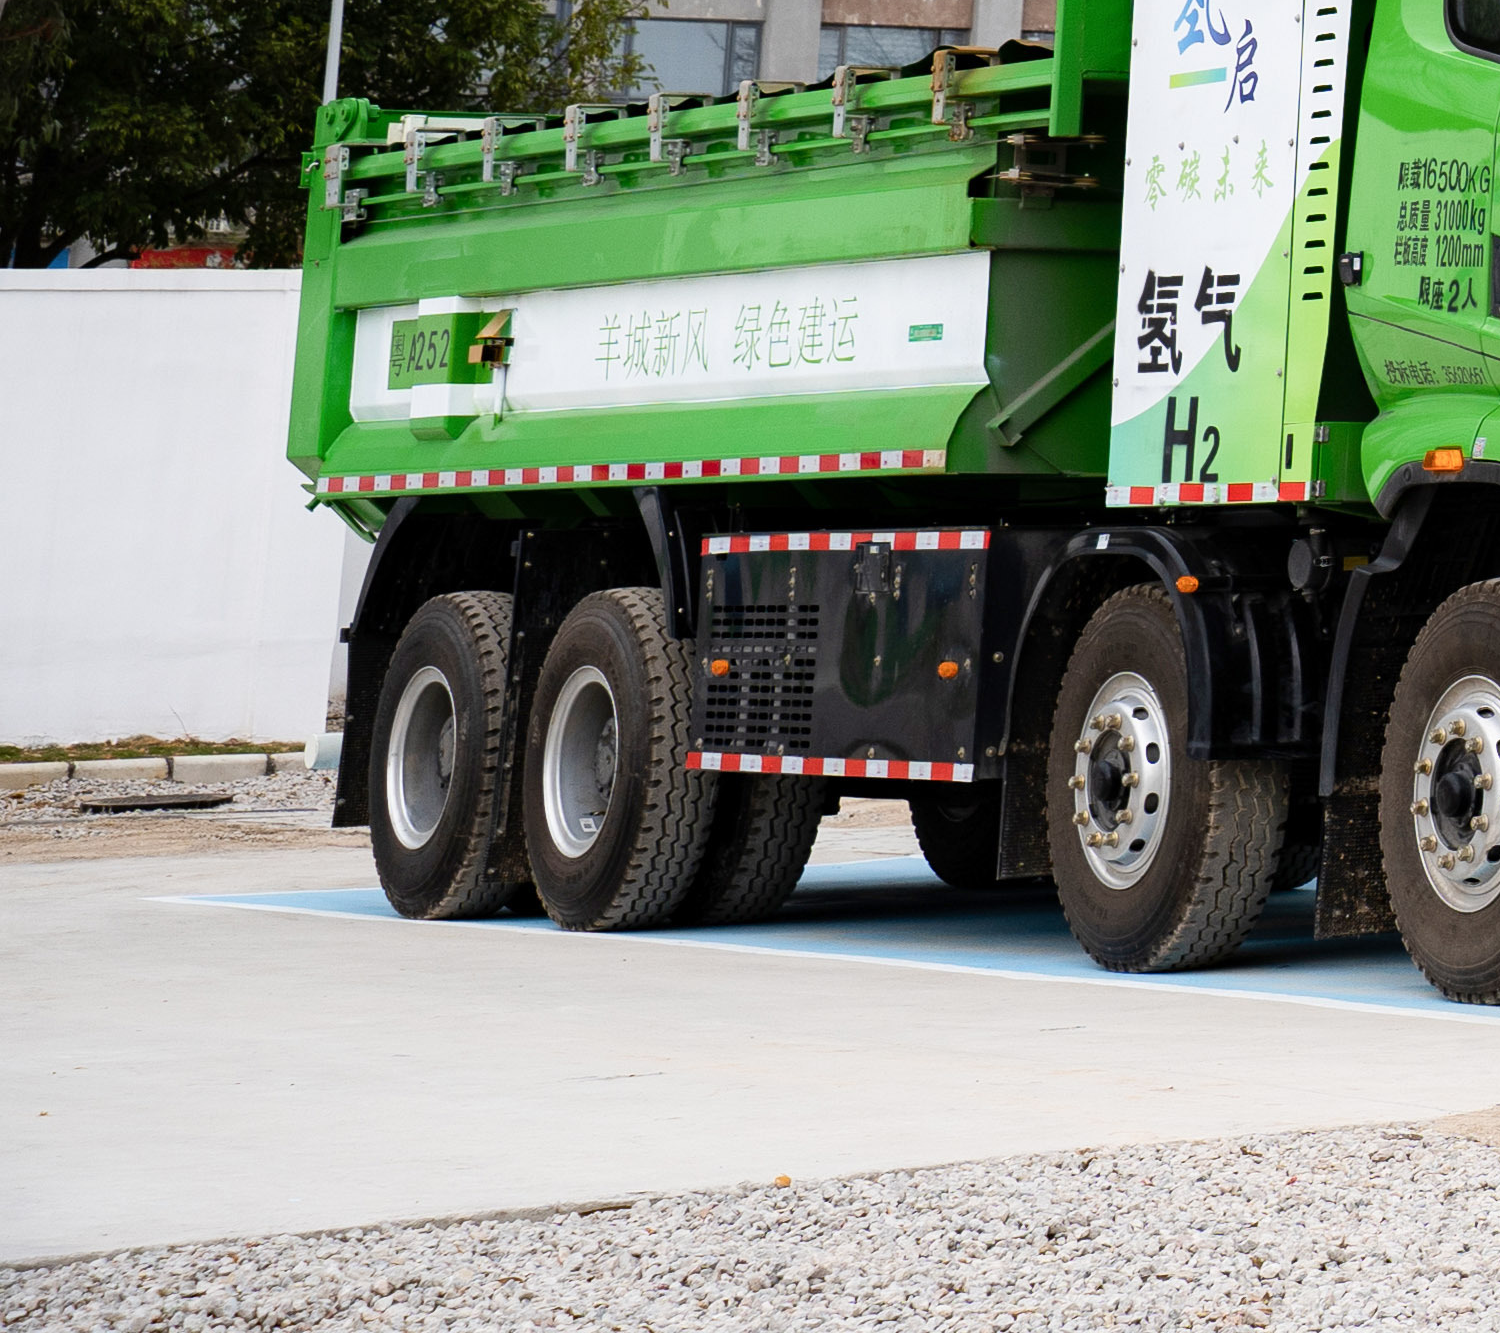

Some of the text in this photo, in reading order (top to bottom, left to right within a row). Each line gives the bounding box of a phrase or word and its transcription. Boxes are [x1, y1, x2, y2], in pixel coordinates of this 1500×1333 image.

[1434, 199, 1486, 235] 31000kg
[1436, 235, 1484, 267] 1200mm
[594, 295, 859, 381] 羊城新风 绿色建运
[1137, 265, 1242, 375] 氢气
